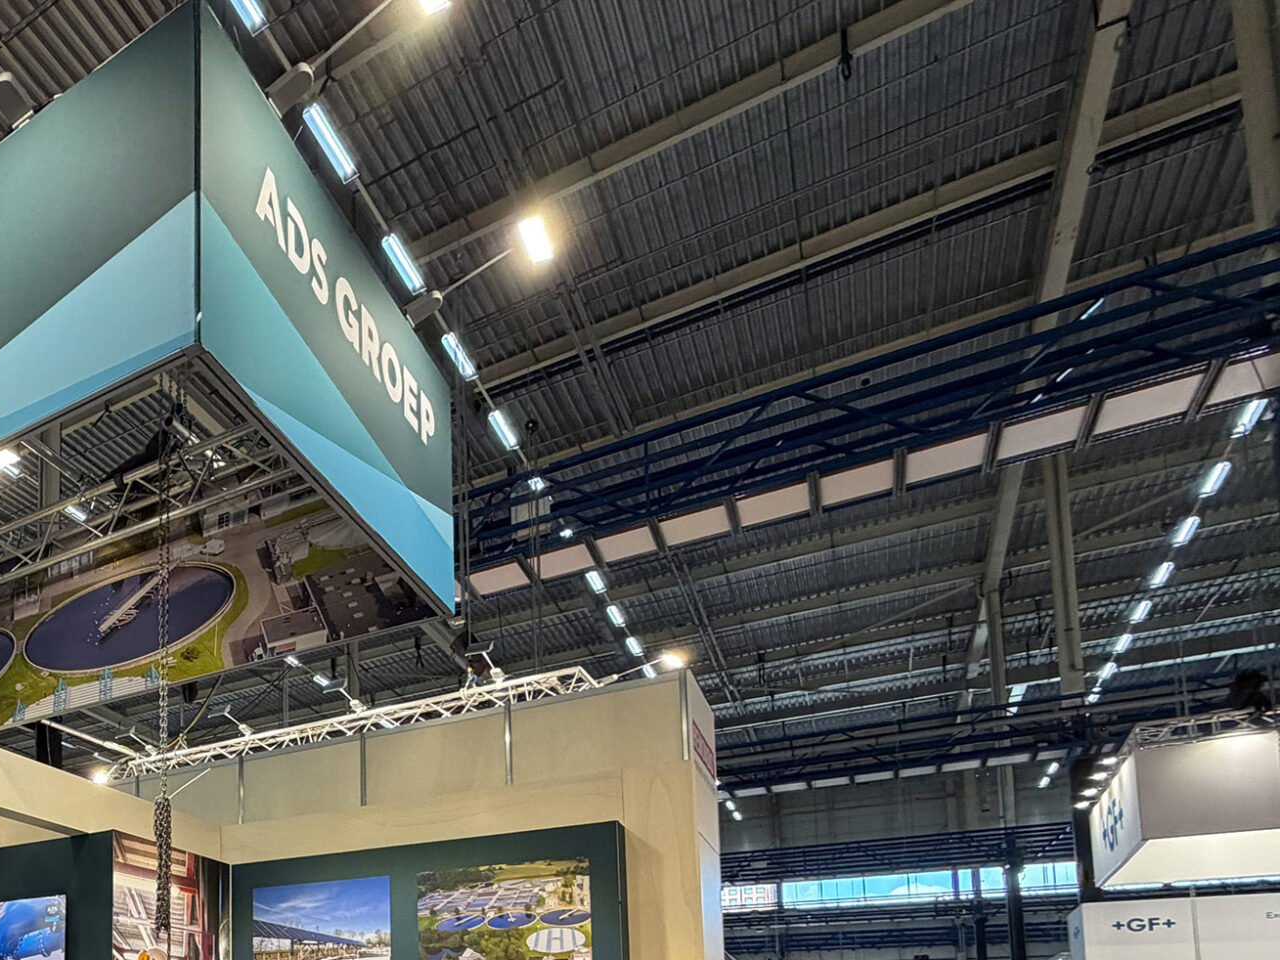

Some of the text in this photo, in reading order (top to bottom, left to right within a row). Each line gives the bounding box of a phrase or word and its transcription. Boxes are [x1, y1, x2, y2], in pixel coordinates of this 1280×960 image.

[255, 166, 436, 446] ADS GROEP
[1112, 918, 1176, 932] +GF+
